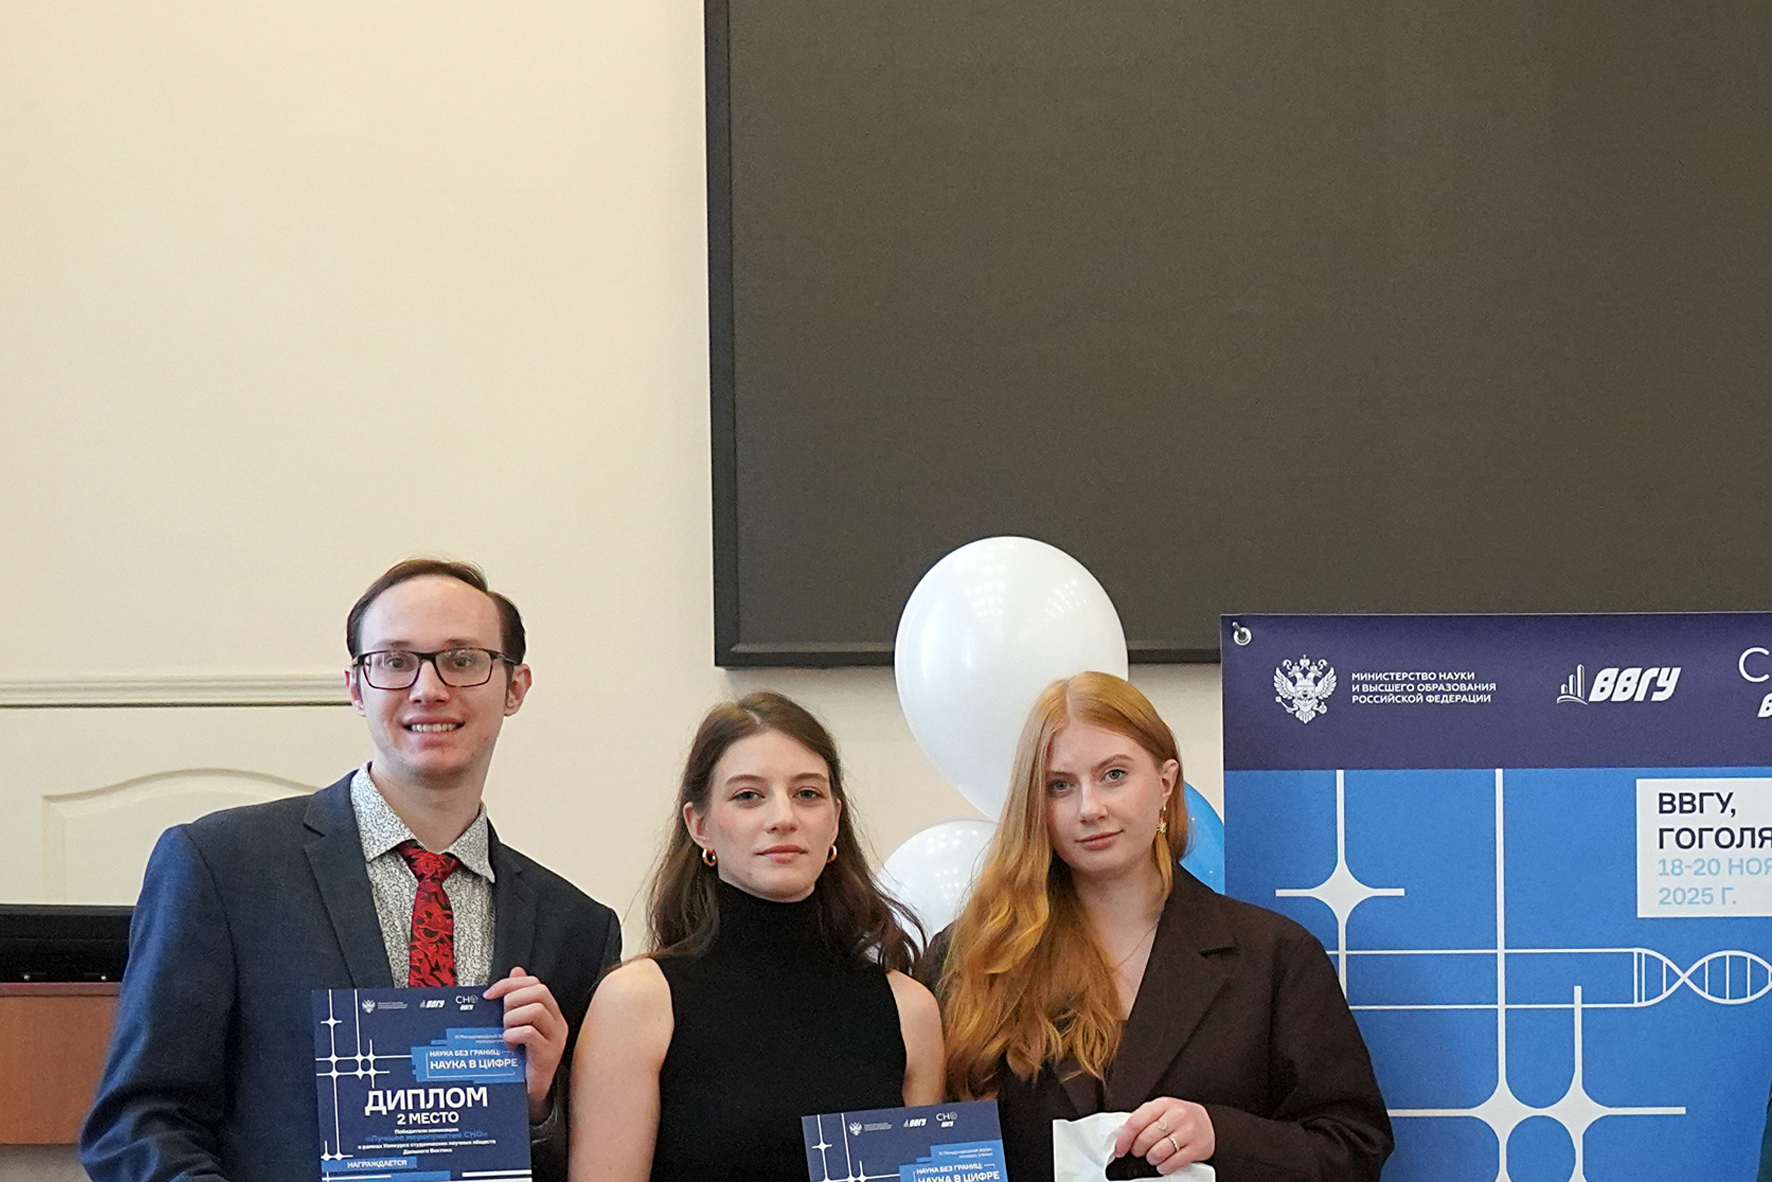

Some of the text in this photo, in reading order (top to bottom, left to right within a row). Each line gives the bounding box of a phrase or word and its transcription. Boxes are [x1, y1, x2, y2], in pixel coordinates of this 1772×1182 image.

[1351, 671, 1475, 681] МИНИСТЕРСТВО НАУКИ
[1351, 682, 1496, 693] И ВЫСШЕГО ОБРАЗОВАНИЯ
[1588, 667, 1682, 702] ВВГУ
[1351, 693, 1492, 704] РОССИЙСКОЙ ФЕДЕРАЦИИ
[1658, 791, 1737, 818] ВВГУ,
[1658, 858, 1721, 877] 18-20
[1658, 887, 1737, 905] 2025 Г.
[430, 1058, 518, 1070] НАУКА В ЦИФРЕ
[364, 1086, 488, 1116] ДИПЛОМ
[397, 1111, 459, 1125] 2 МЕСТО
[347, 1159, 408, 1169] НАГРАЖДАЕТСЯ
[917, 1167, 939, 1175] НАУКА
[940, 1165, 953, 1173] БЕЗ
